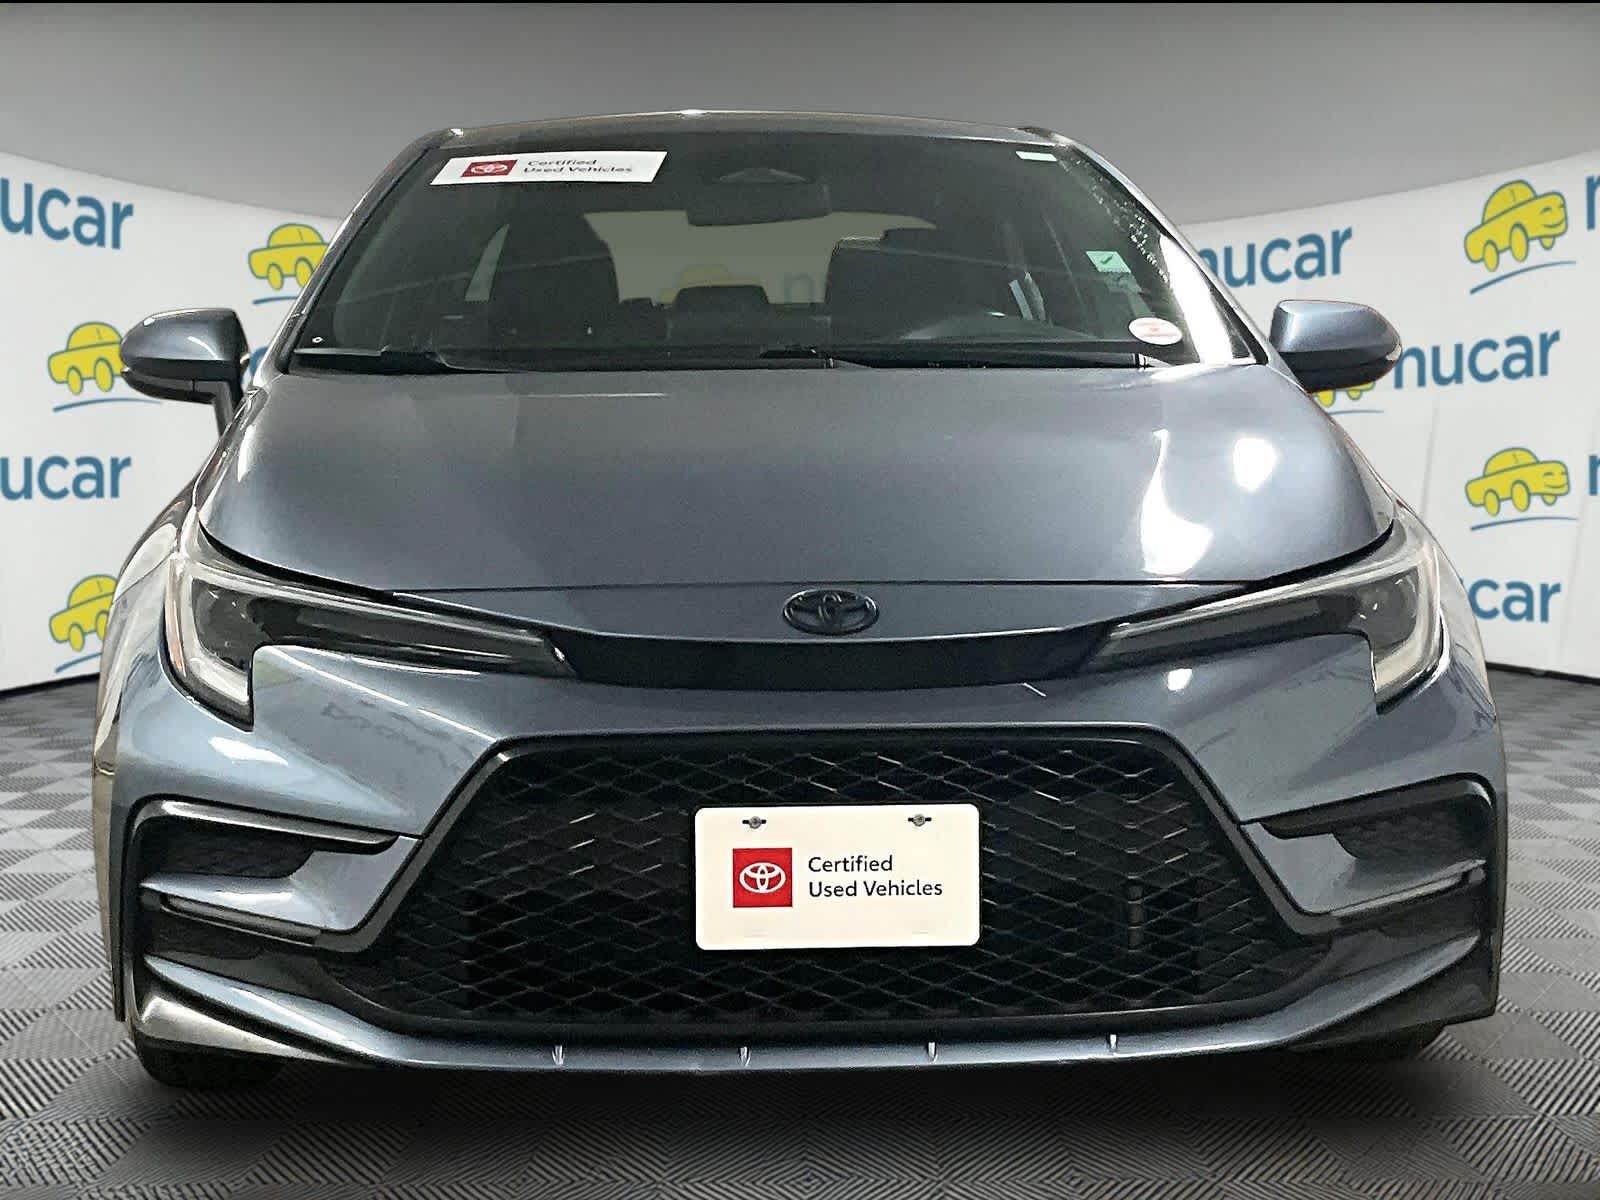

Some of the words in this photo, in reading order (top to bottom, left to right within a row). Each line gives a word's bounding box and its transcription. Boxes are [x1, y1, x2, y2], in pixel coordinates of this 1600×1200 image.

[1394, 330, 1561, 389] nucar
[1460, 578, 1562, 623] car
[808, 855, 893, 873] Certified
[808, 881, 858, 898] Used
[863, 880, 943, 897] Vehicles
